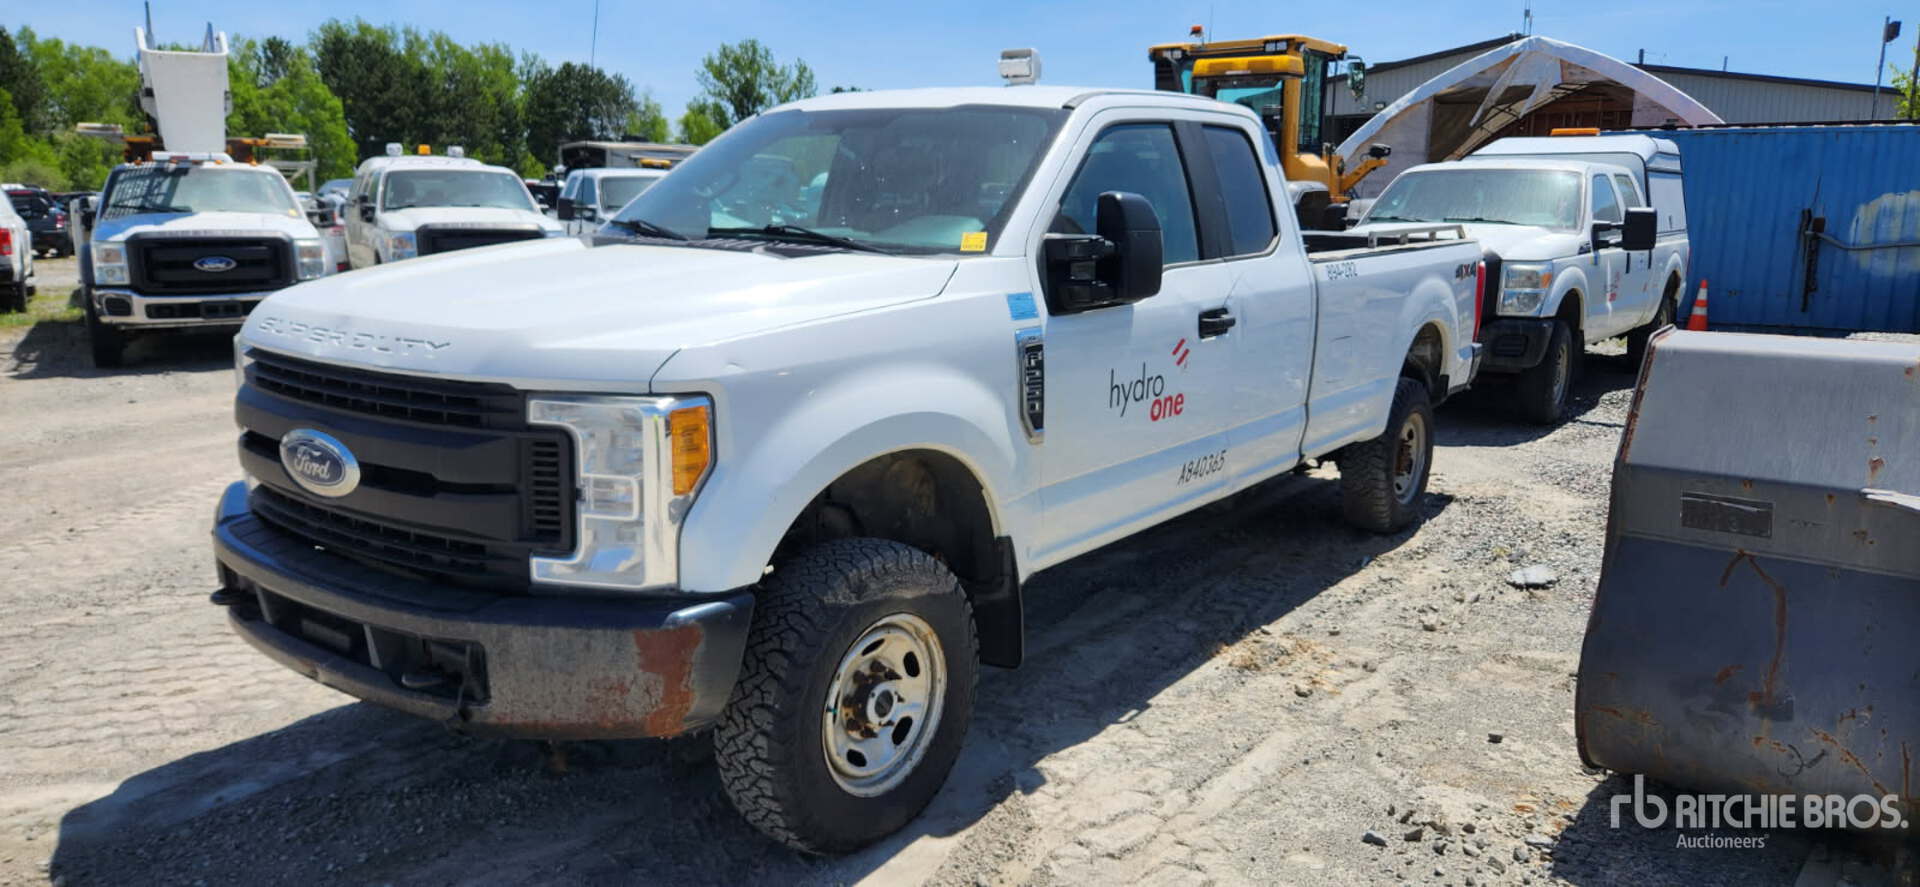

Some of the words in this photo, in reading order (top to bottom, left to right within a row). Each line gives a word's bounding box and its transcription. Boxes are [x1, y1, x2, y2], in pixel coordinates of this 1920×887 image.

[259, 316, 347, 346] SUPER
[352, 332, 450, 358] DUTY
[1110, 361, 1164, 418] hydro
[1150, 393, 1184, 422] one
[294, 446, 331, 479] Ford
[1178, 450, 1227, 485] A840365
